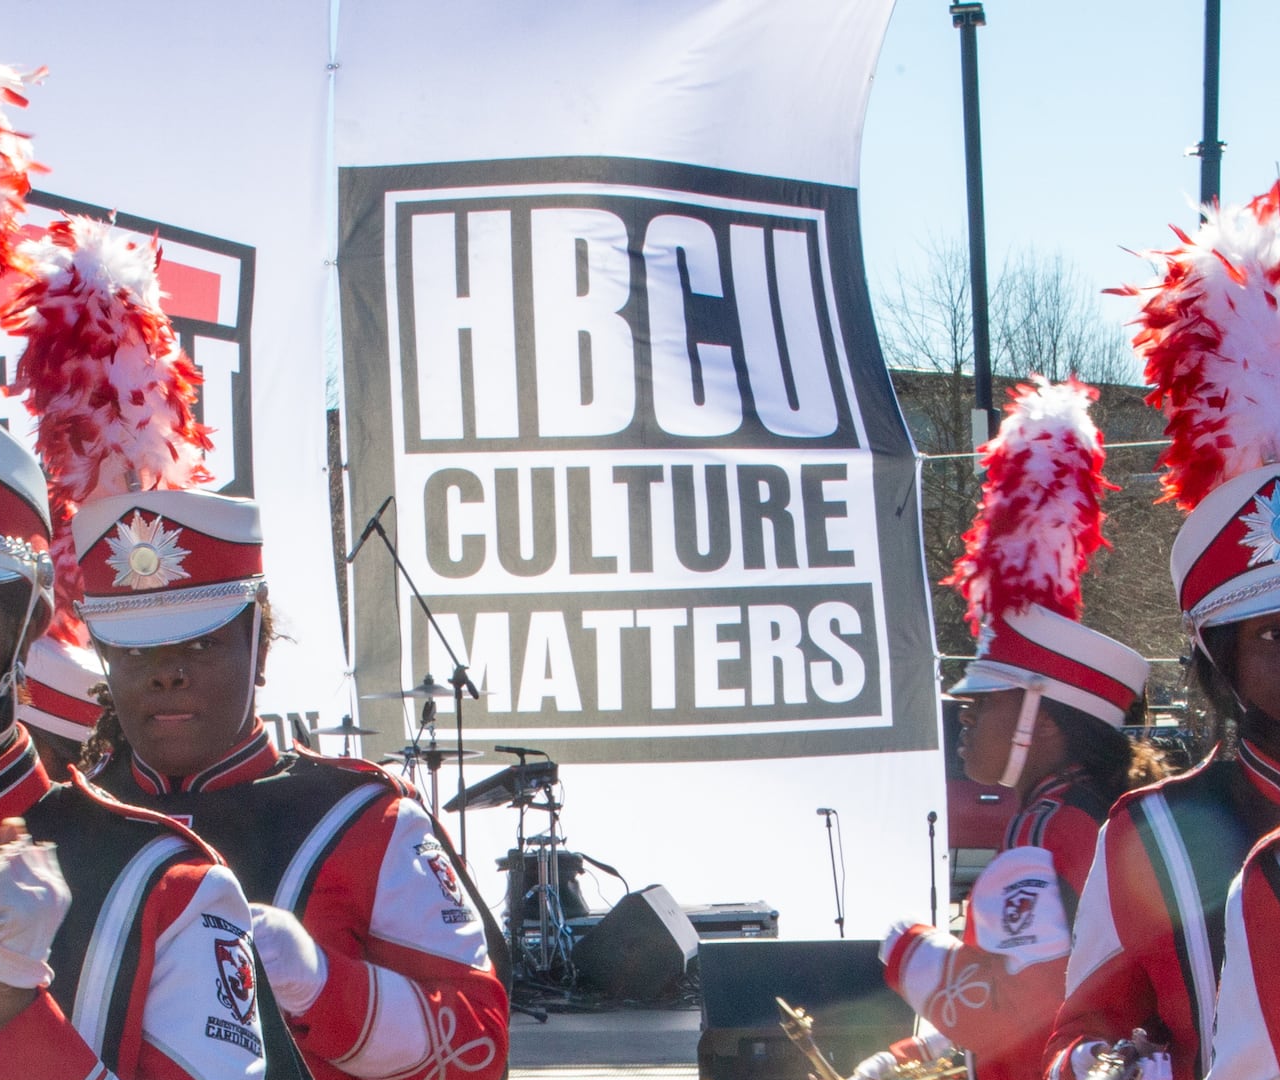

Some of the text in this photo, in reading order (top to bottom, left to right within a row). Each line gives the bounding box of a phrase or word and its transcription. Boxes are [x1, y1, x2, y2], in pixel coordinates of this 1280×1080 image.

[410, 207, 840, 442] HBCU
[423, 464, 856, 579] CULTURE
[425, 600, 866, 714] MATTERS
